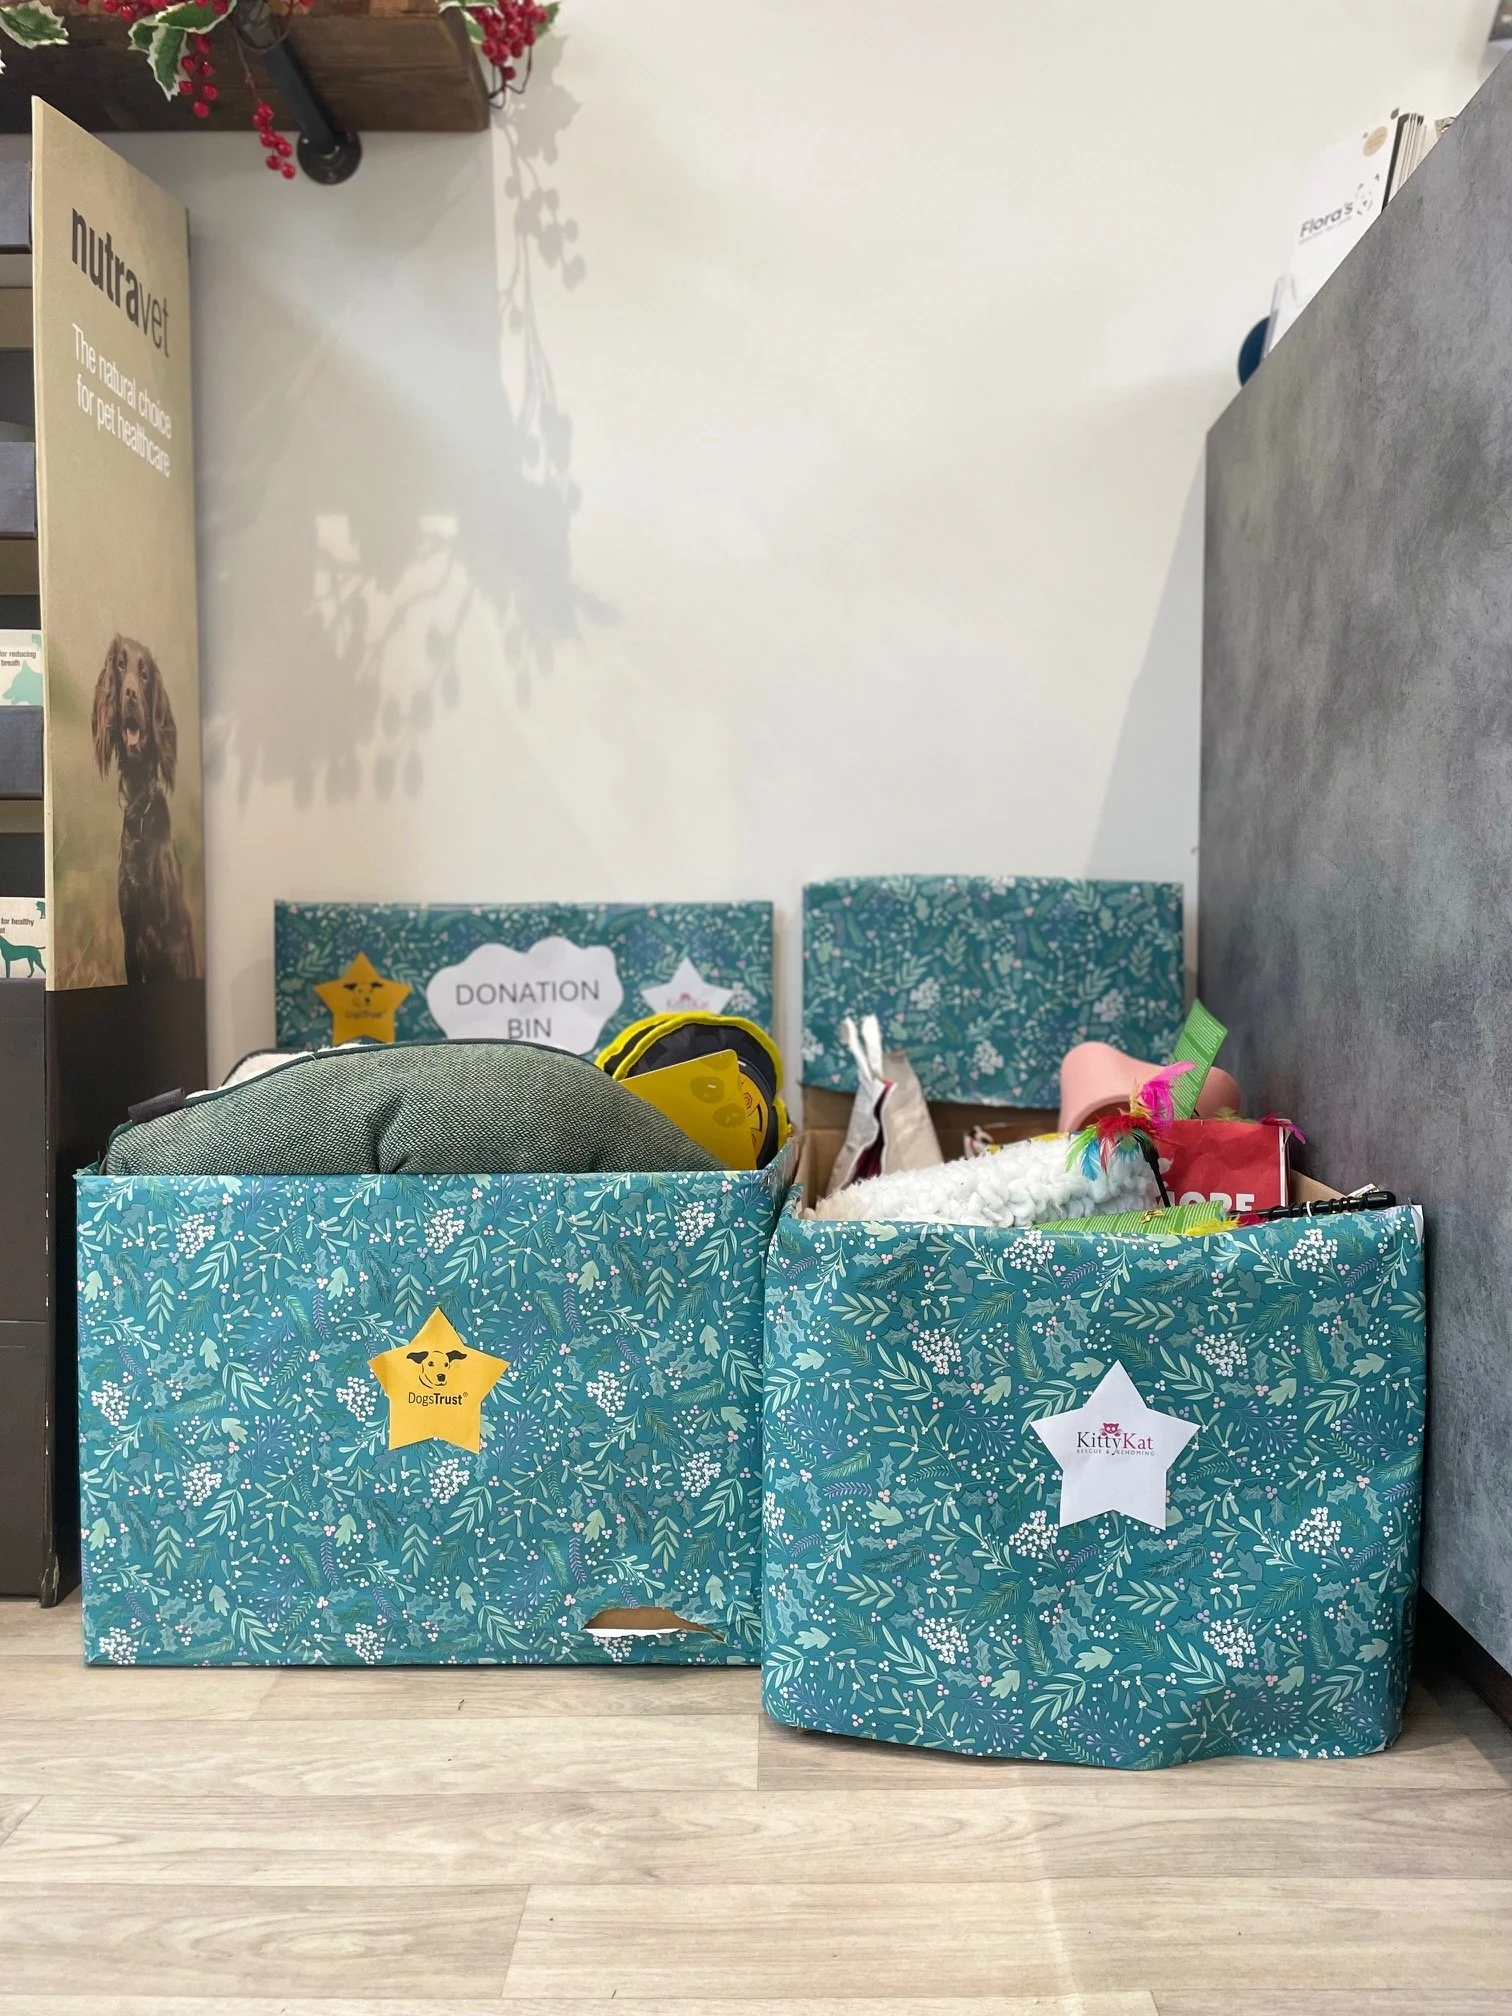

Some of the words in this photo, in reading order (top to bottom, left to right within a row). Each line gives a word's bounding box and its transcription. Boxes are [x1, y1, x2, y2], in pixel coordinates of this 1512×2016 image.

[1300, 201, 1354, 238] Flora's
[72, 207, 169, 358] nutravet
[72, 322, 96, 374] The
[99, 354, 137, 410] natural
[138, 389, 172, 440] choice
[76, 373, 95, 416] for
[97, 397, 116, 436] pet
[117, 406, 170, 479] healthcare
[11, 917, 35, 927] healthy
[456, 980, 600, 1006] DONATION
[507, 1017, 552, 1040] BIN
[1076, 1431, 1154, 1456] KittyKat
